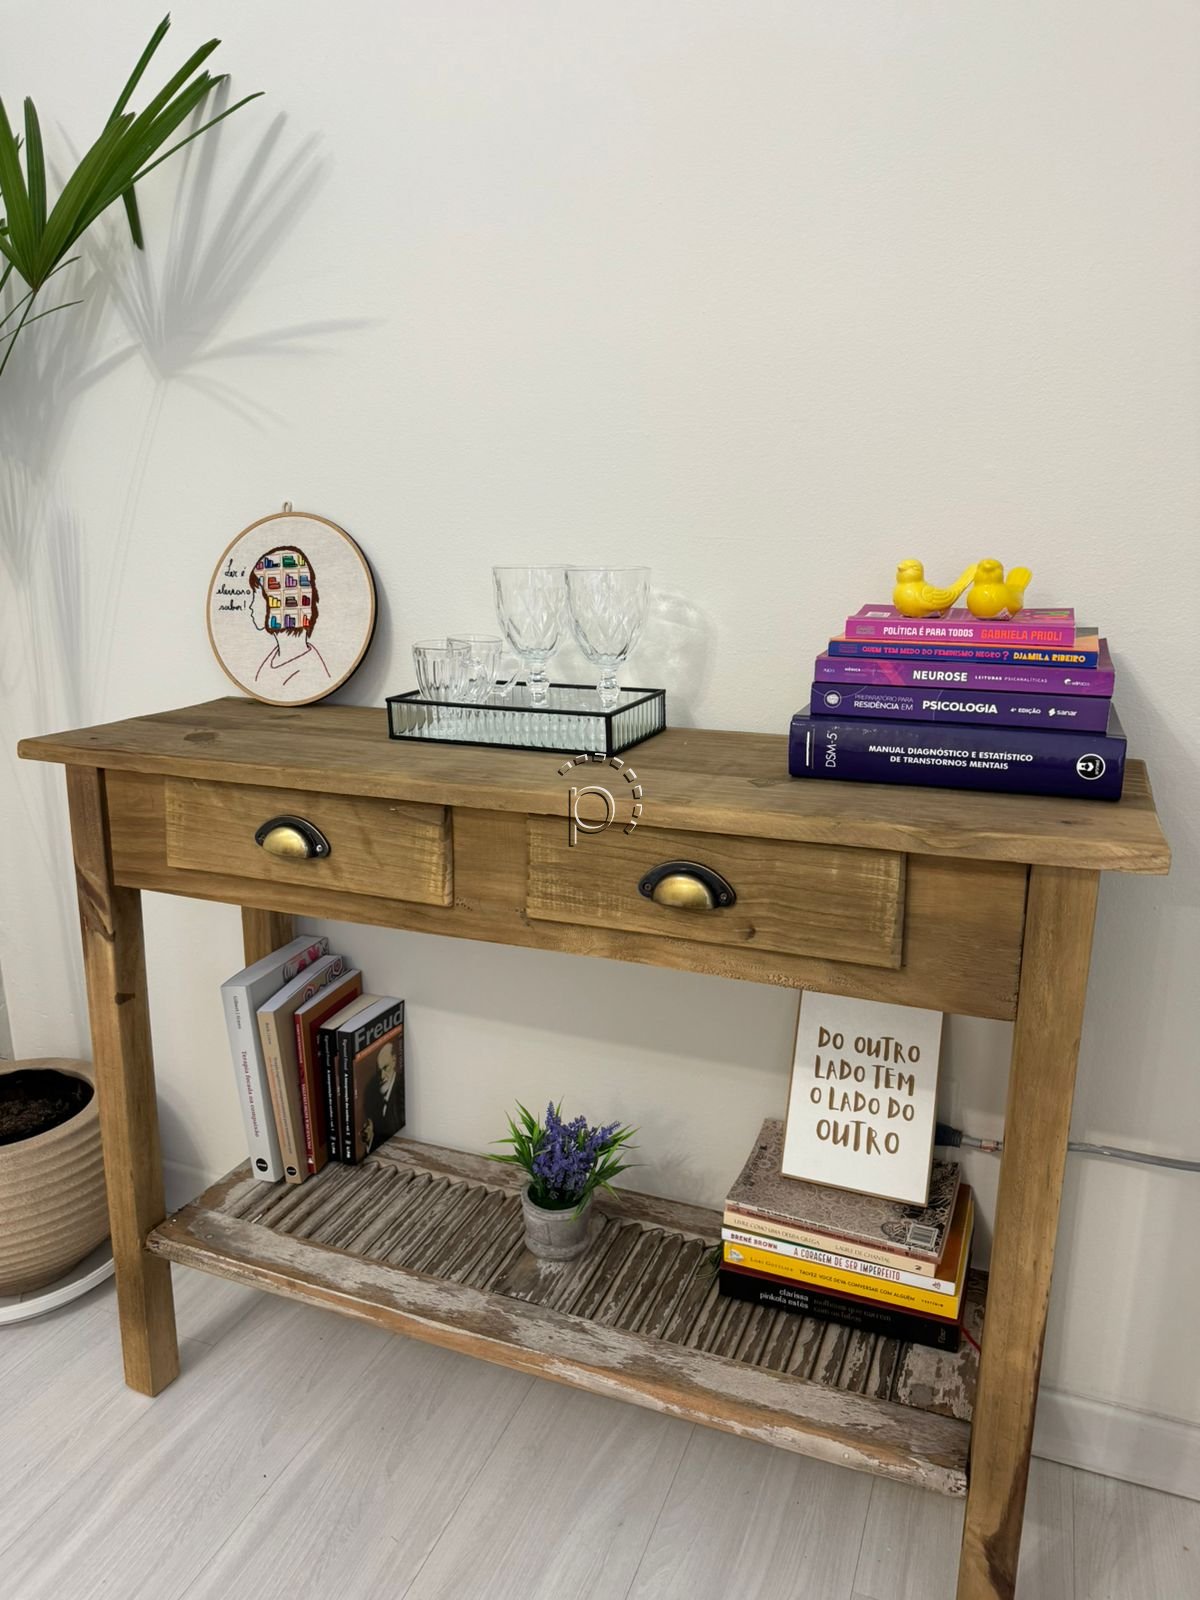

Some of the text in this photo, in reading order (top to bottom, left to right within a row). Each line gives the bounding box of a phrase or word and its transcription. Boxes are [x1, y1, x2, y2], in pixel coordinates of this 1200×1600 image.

[883, 625, 917, 637] POLÍTICA
[918, 625, 924, 636] É
[925, 627, 946, 637] PARA
[948, 628, 974, 638] TODOS
[981, 628, 1062, 641] GABRIELA PRIOLI
[900, 647, 920, 655] MEDO
[934, 649, 974, 657] FEMINISMO
[1013, 652, 1086, 663] DJAMILA RIBEIRO
[912, 670, 968, 682] NEUROSE
[854, 693, 897, 702] PREPARATÓRIO
[854, 700, 914, 711] RESIDÊNCIA EM
[922, 700, 998, 714] PSICOLOGIA
[1018, 707, 1041, 715] EDIÇÃO
[1056, 709, 1077, 717] sanar
[825, 731, 838, 768] DSM-5
[869, 745, 905, 754] MANUAL
[907, 747, 969, 758] DIAGNÓSTICO
[979, 751, 1033, 762] ESTATÍSTICO
[890, 755, 1009, 770] DE TRANSTORNOS MENTAIS
[354, 1003, 404, 1053] Freud
[817, 1025, 920, 1063] DO OUTRO
[241, 1051, 250, 1074] Terapia
[814, 1054, 915, 1096] LADO TEM
[249, 1095, 254, 1104] na
[810, 1086, 915, 1122] O LADO DO
[250, 1104, 260, 1138] compaixão
[816, 1119, 900, 1155] OUTRO
[730, 1232, 777, 1250] BRENÉ BROWN
[793, 1246, 900, 1281] A CORAGEM DE SER IMPERFEITO
[799, 1268, 817, 1279] TALVEZ
[833, 1276, 846, 1286] DEVA
[847, 1279, 878, 1293] CONVERSAR
[879, 1287, 892, 1296] COM
[759, 1291, 809, 1309] pinkola estés
[779, 1288, 809, 1301] clarissa
